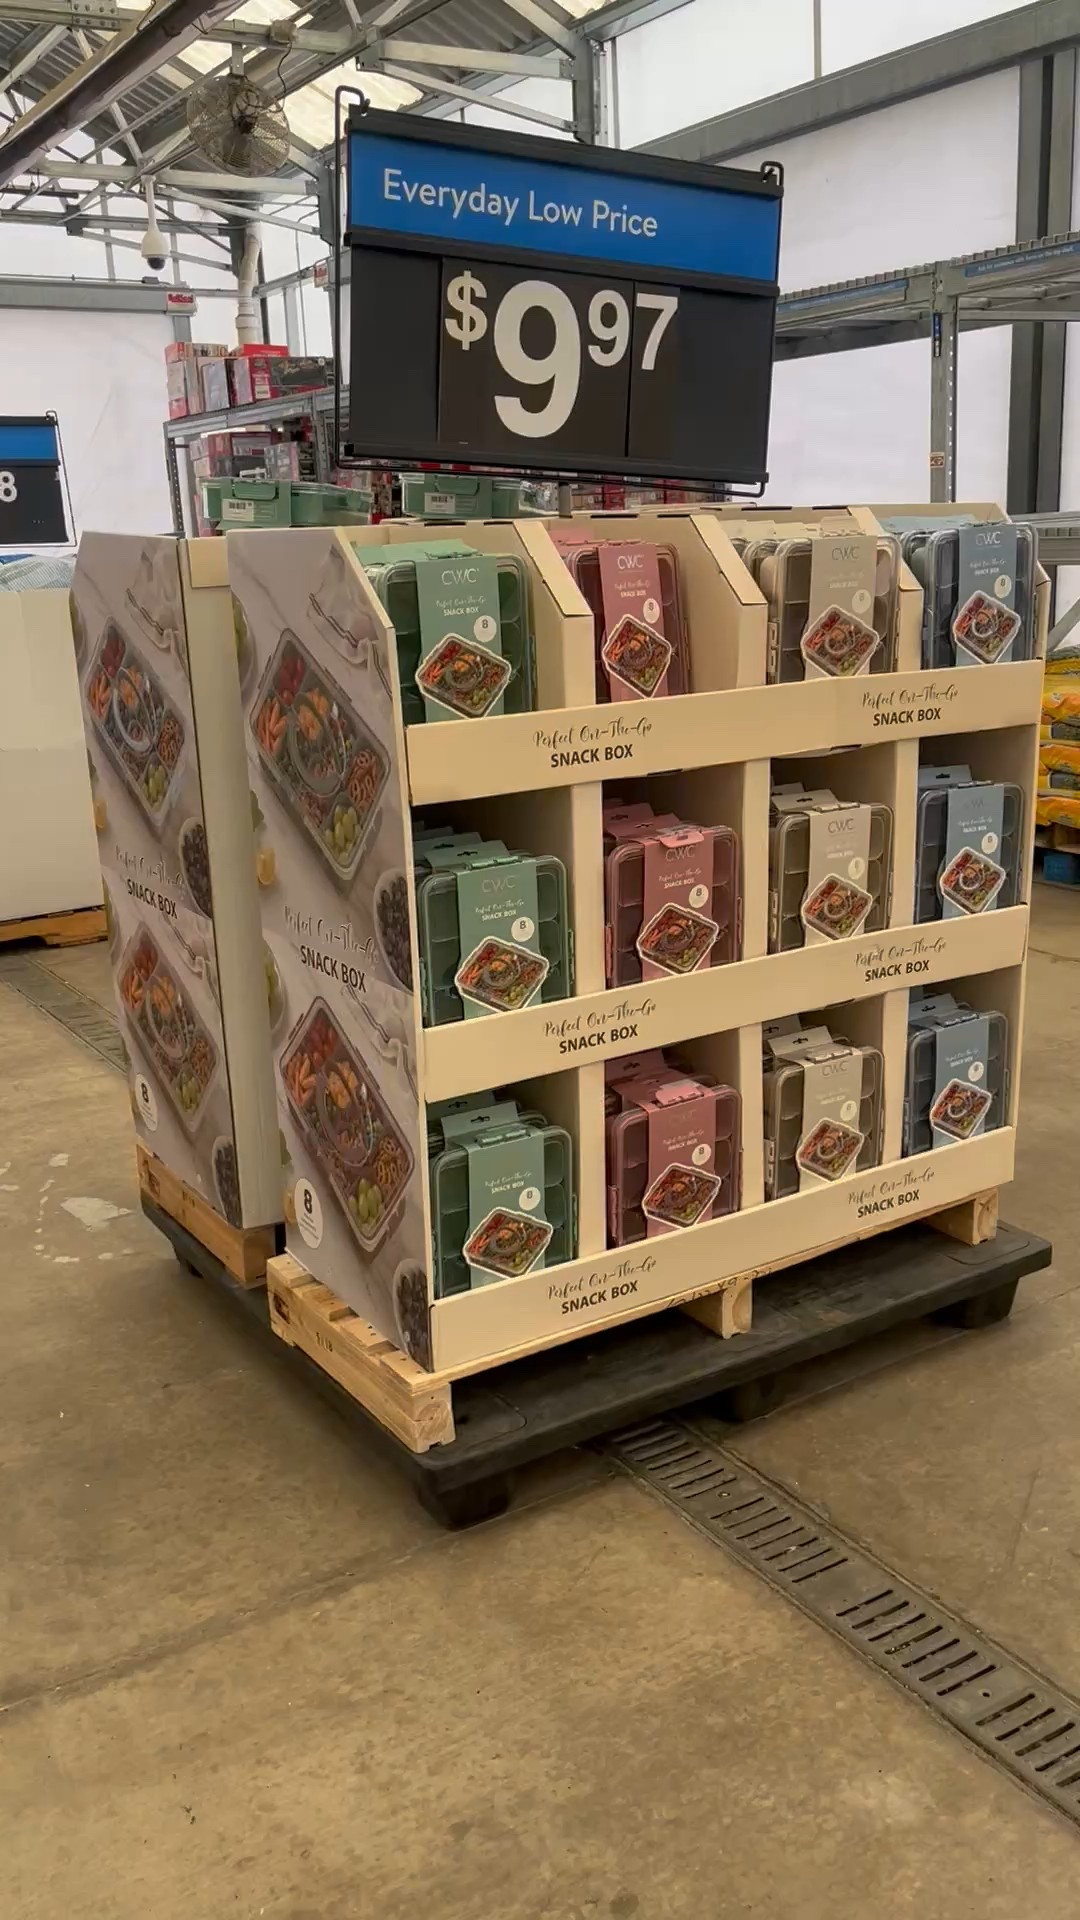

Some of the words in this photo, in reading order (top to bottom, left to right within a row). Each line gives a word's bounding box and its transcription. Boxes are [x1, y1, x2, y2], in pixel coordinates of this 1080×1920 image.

[383, 167, 519, 226] Everyday
[528, 190, 582, 227] Low
[592, 199, 658, 237] Price
[0, 471, 17, 502] 8
[617, 554, 644, 569] CWC
[832, 546, 859, 560] CWC
[441, 567, 478, 585] CWC
[482, 619, 488, 628] 8
[873, 709, 914, 726] SNACK
[917, 707, 941, 721] BOX
[533, 725, 574, 749] Perfect
[550, 748, 600, 768] SNACK
[605, 744, 633, 761] BOX
[828, 818, 854, 834] CWC
[665, 845, 696, 862] CWC
[481, 875, 516, 892] CWC
[127, 879, 157, 908] SNACK
[158, 894, 177, 919] BOX
[519, 920, 526, 929] 8
[300, 945, 339, 980] SNACK
[341, 962, 366, 993] BOX
[865, 964, 902, 982] SNACK
[906, 960, 930, 974] BOX
[543, 1015, 581, 1037] Perfect
[559, 1031, 606, 1054] SNACK
[610, 1024, 638, 1042] BOX
[141, 1083, 149, 1103] 8
[304, 1188, 313, 1214] 8
[857, 1197, 894, 1218] SNACK
[898, 1189, 920, 1206] BOX
[547, 1277, 584, 1299] Perfect
[561, 1290, 607, 1314] SNACK
[611, 1280, 638, 1299] BOX
